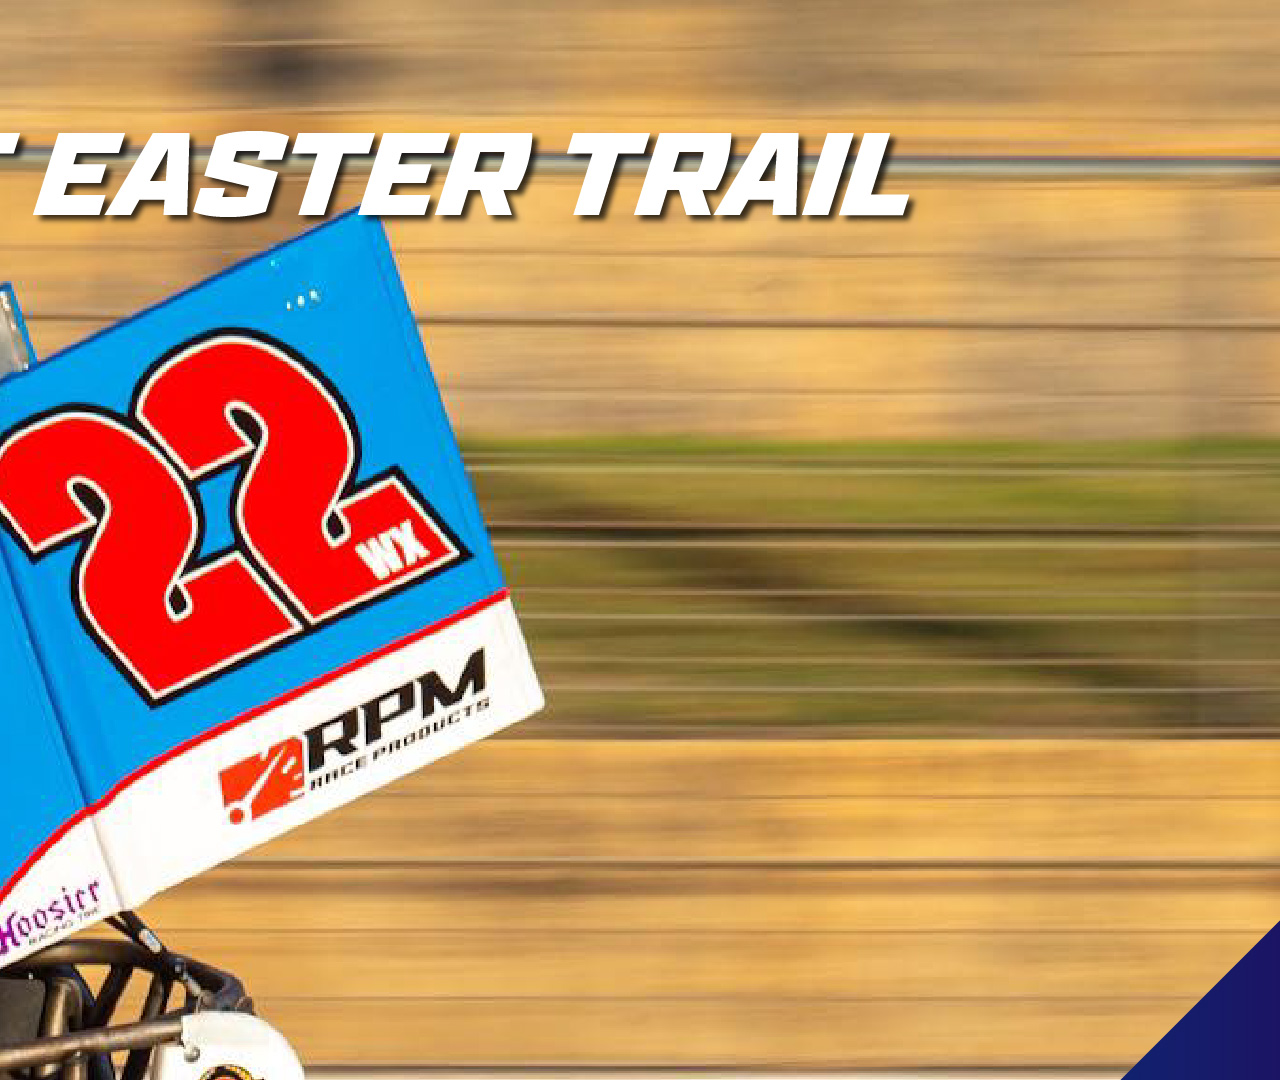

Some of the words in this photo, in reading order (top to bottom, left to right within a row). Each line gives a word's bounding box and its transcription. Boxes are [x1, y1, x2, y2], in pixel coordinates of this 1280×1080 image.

[355, 519, 430, 580] WX
[304, 648, 486, 772] RPM
[310, 757, 366, 791] RACE
[372, 696, 491, 762] PRODUCTS
